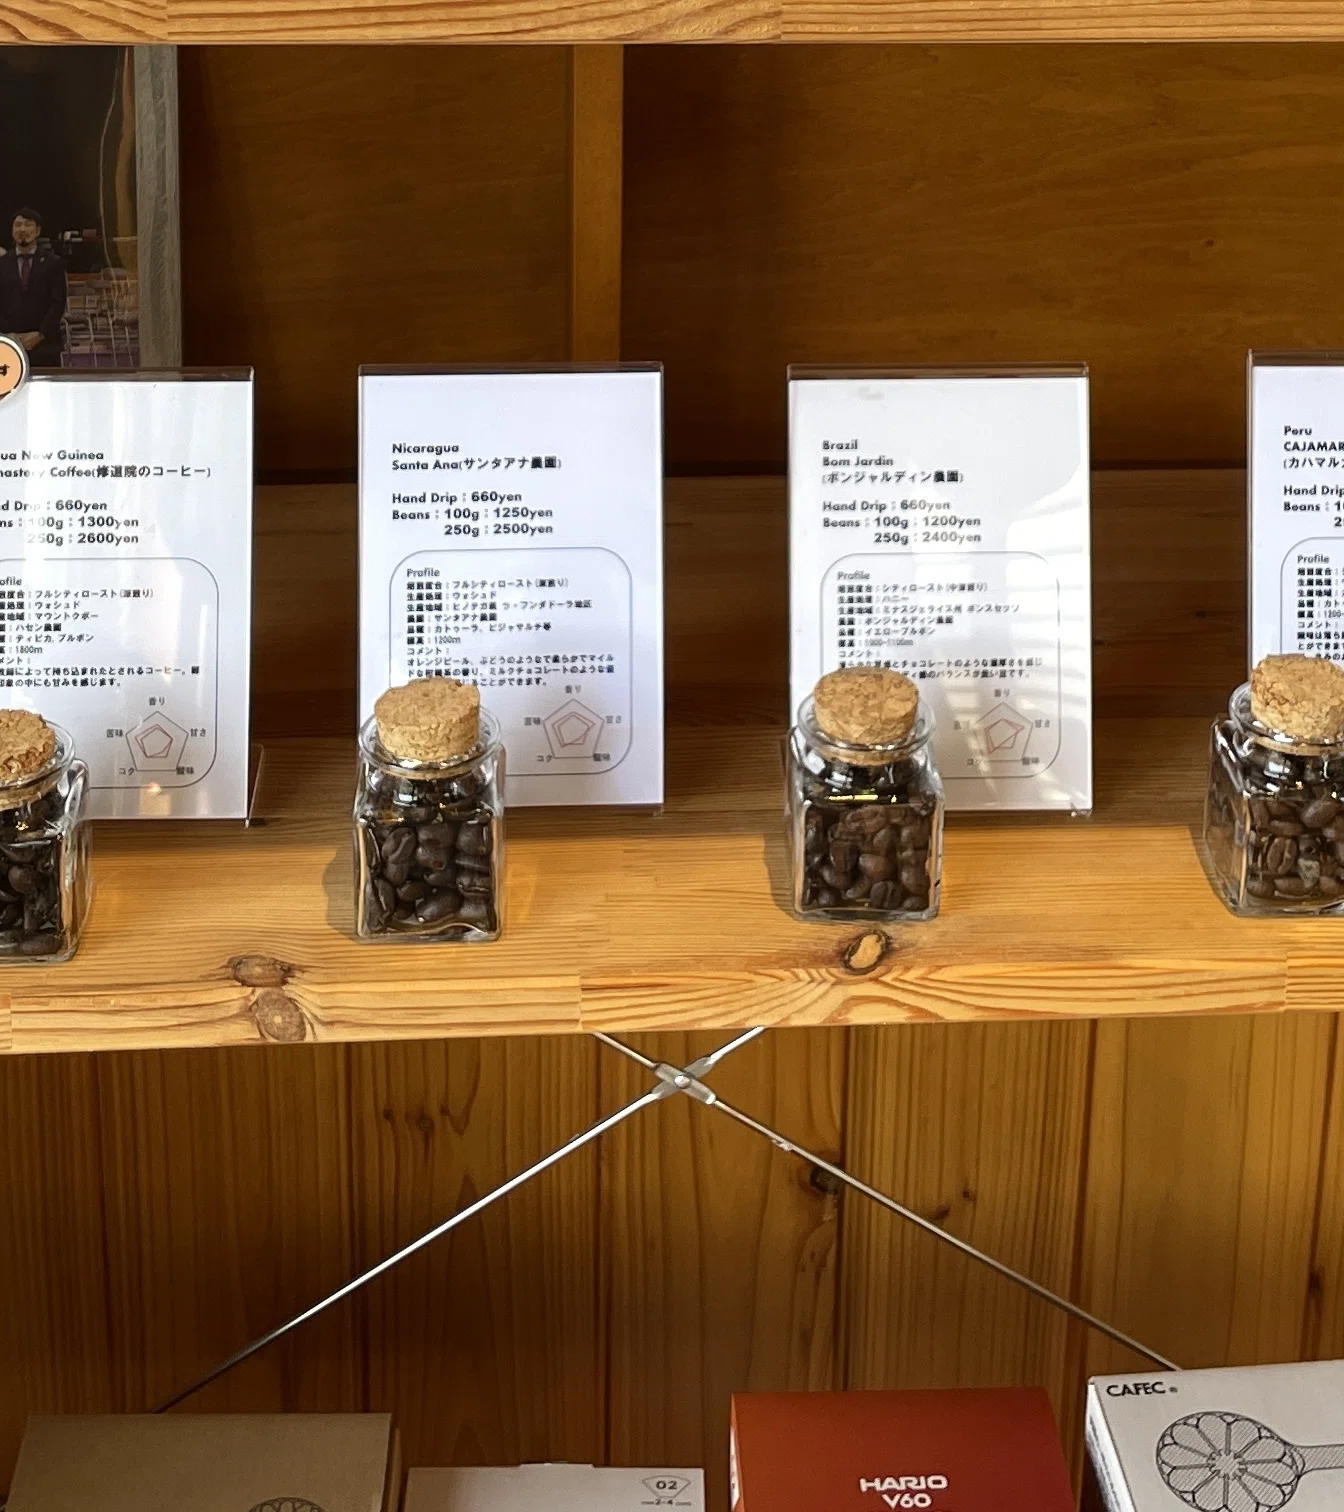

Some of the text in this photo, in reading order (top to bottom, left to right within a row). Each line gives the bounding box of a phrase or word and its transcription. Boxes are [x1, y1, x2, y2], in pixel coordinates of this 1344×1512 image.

[1284, 426, 1312, 436] Peru
[392, 443, 459, 455] Nicaragua
[822, 440, 858, 450] Brazil
[57, 450, 104, 461] Guinea
[822, 455, 893, 466] Bom Jardin
[392, 460, 428, 470] Santa
[1297, 555, 1329, 564] Profile
[1107, 1381, 1166, 1397] CAFEC
[655, 1481, 677, 1490] 02
[860, 1475, 948, 1493] HARIO
[881, 1493, 932, 1509] V60
